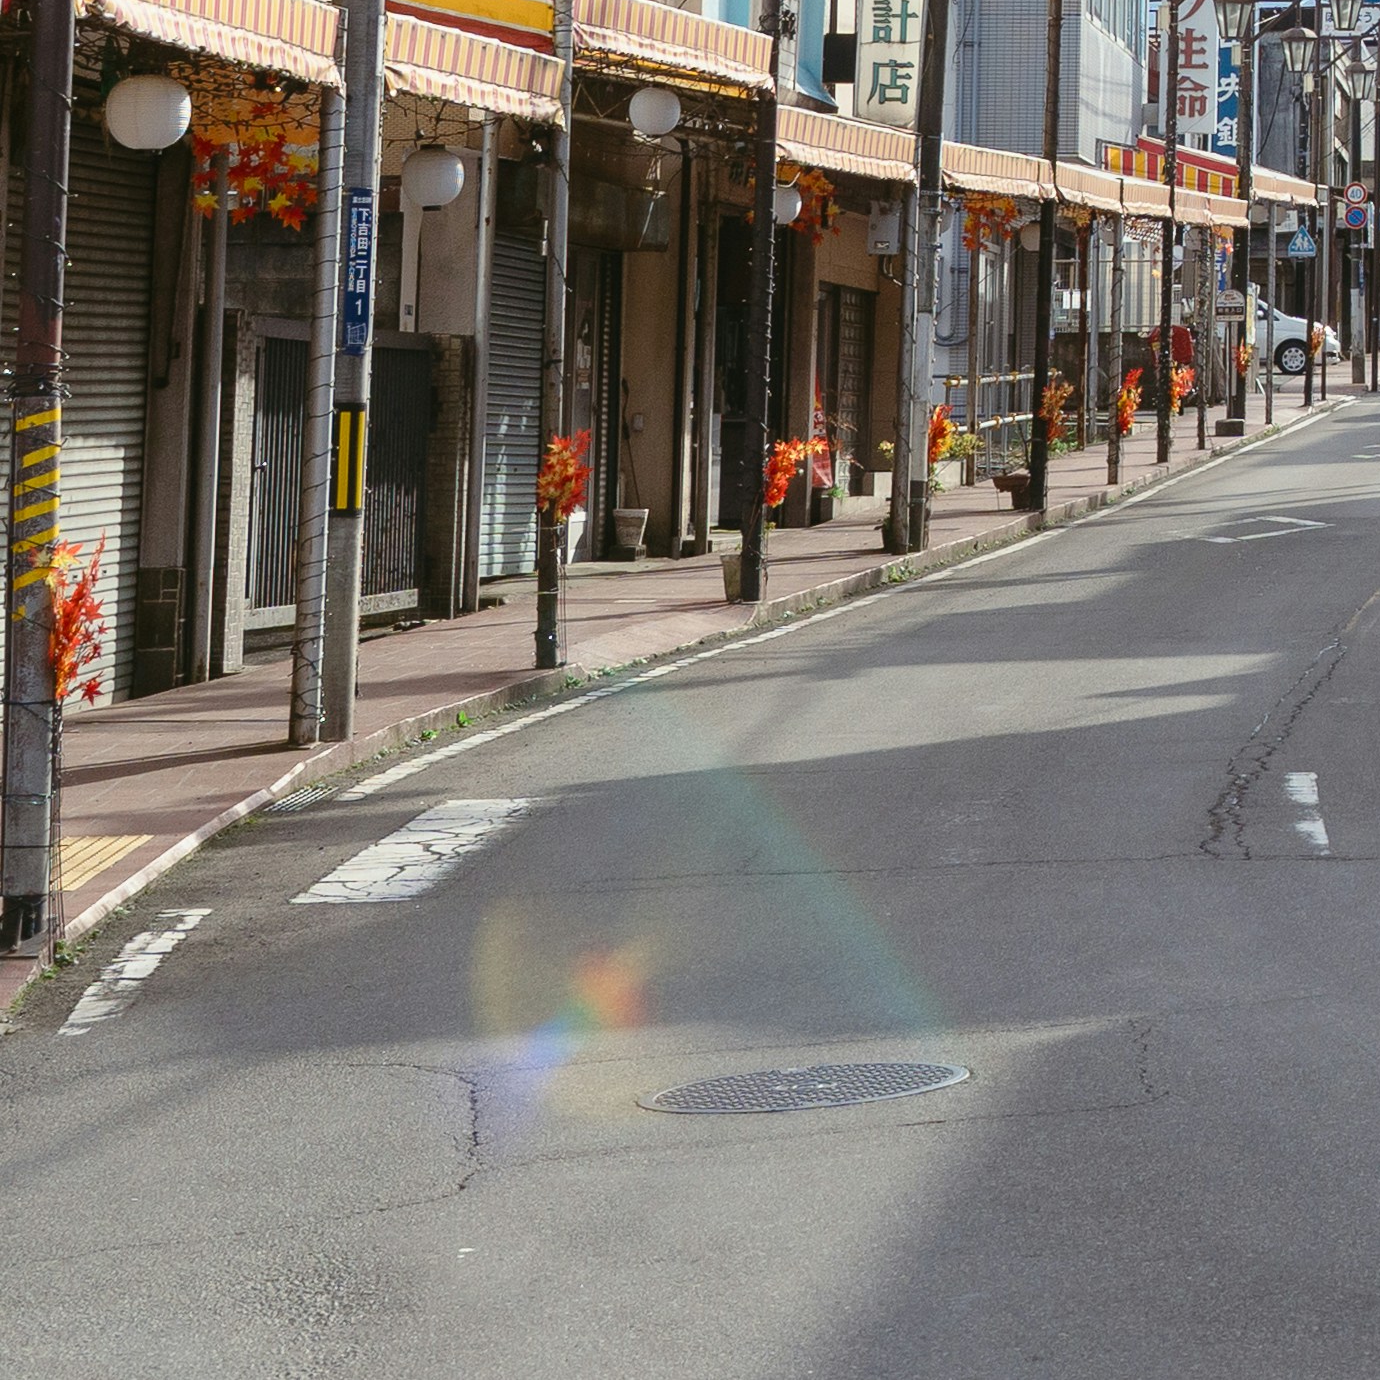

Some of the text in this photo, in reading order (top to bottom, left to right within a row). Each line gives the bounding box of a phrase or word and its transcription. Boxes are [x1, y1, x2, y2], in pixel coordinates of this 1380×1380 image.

[1349, 188, 1362, 200] 40
[355, 207, 371, 294] 下吉田二丁目
[355, 299, 362, 316] 1
